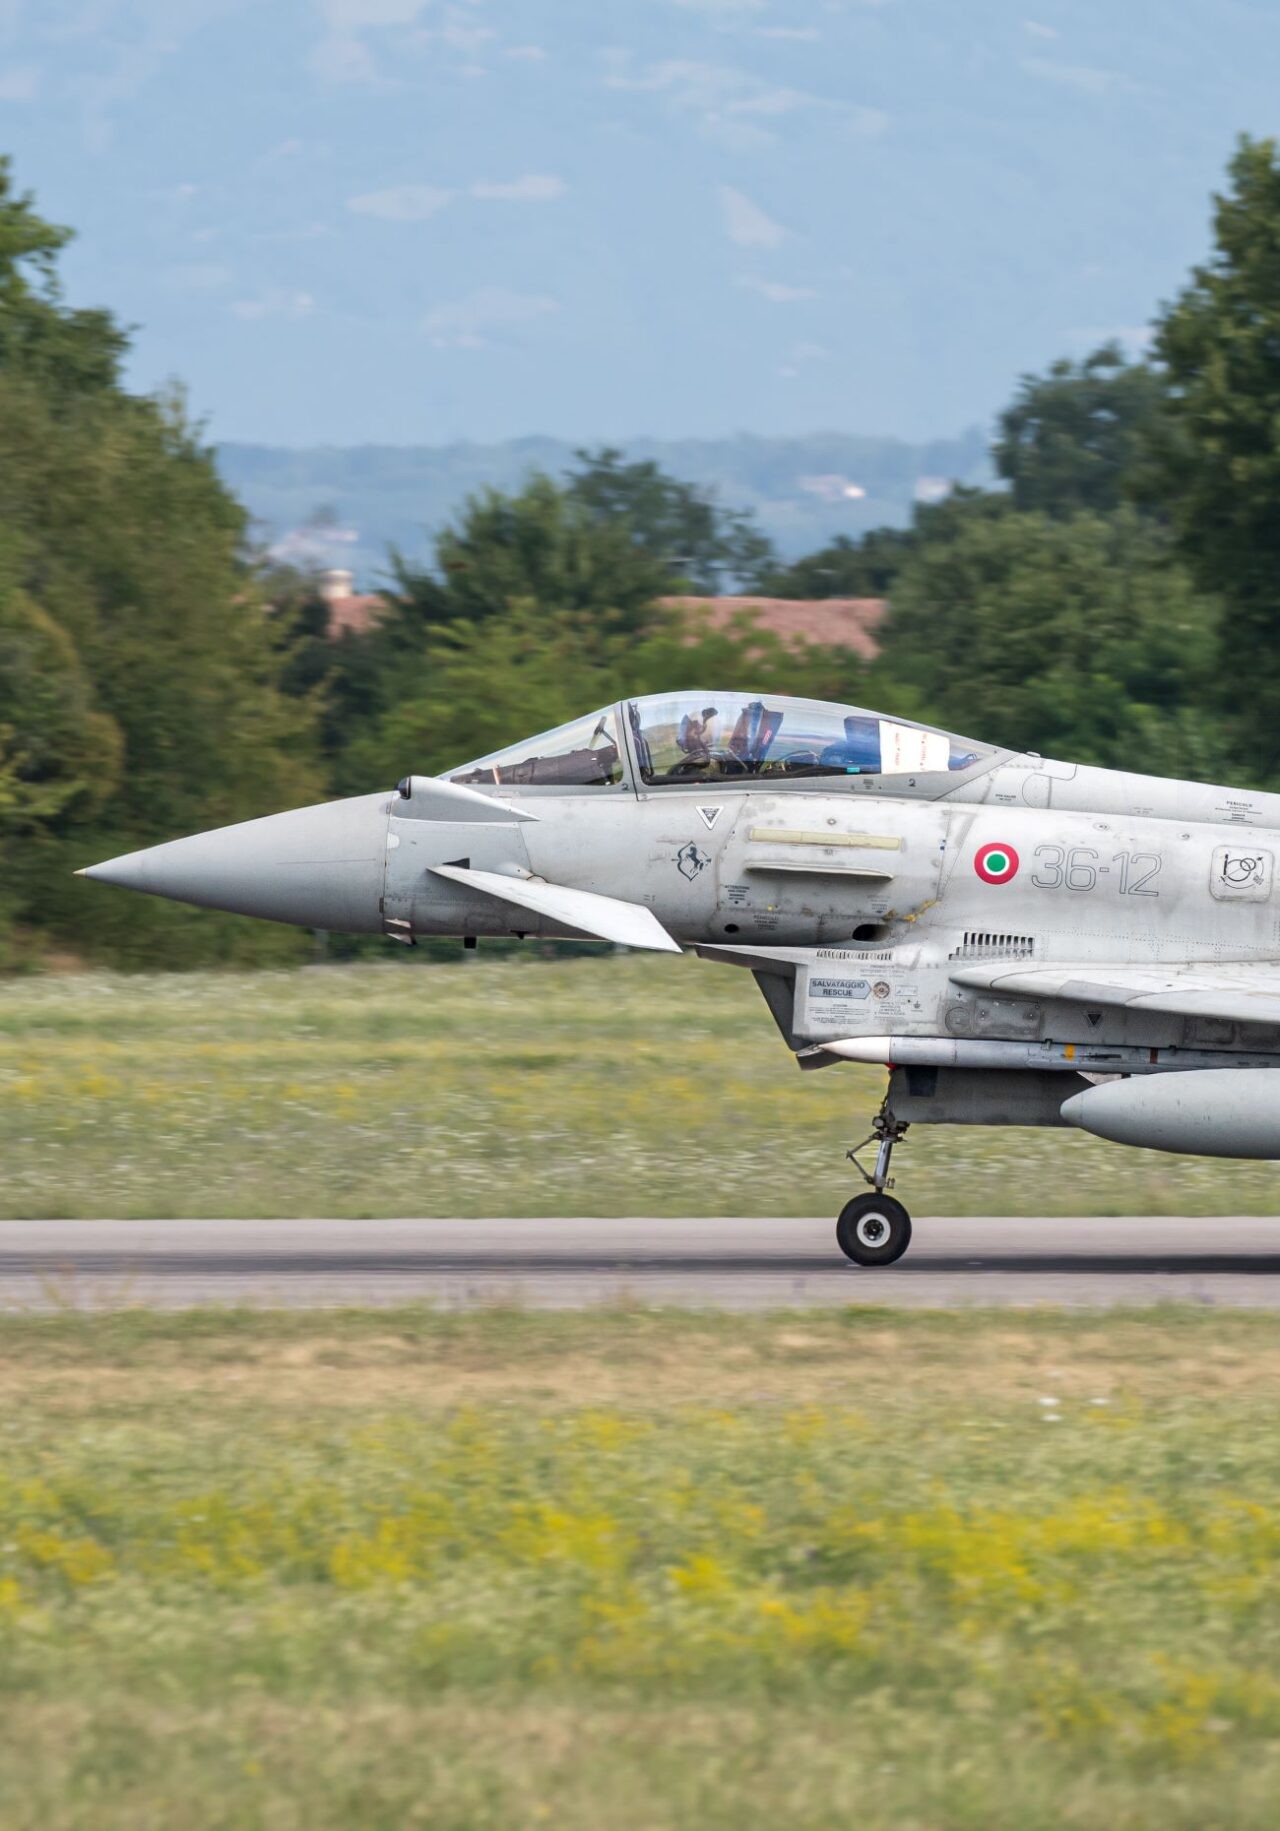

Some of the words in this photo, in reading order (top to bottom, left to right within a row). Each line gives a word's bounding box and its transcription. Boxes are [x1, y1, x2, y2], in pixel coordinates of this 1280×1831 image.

[908, 778, 916, 787] 2
[1031, 844, 1162, 898] 36-12
[812, 981, 865, 989] SALVATAGGIO
[823, 988, 853, 996] RESCUE
